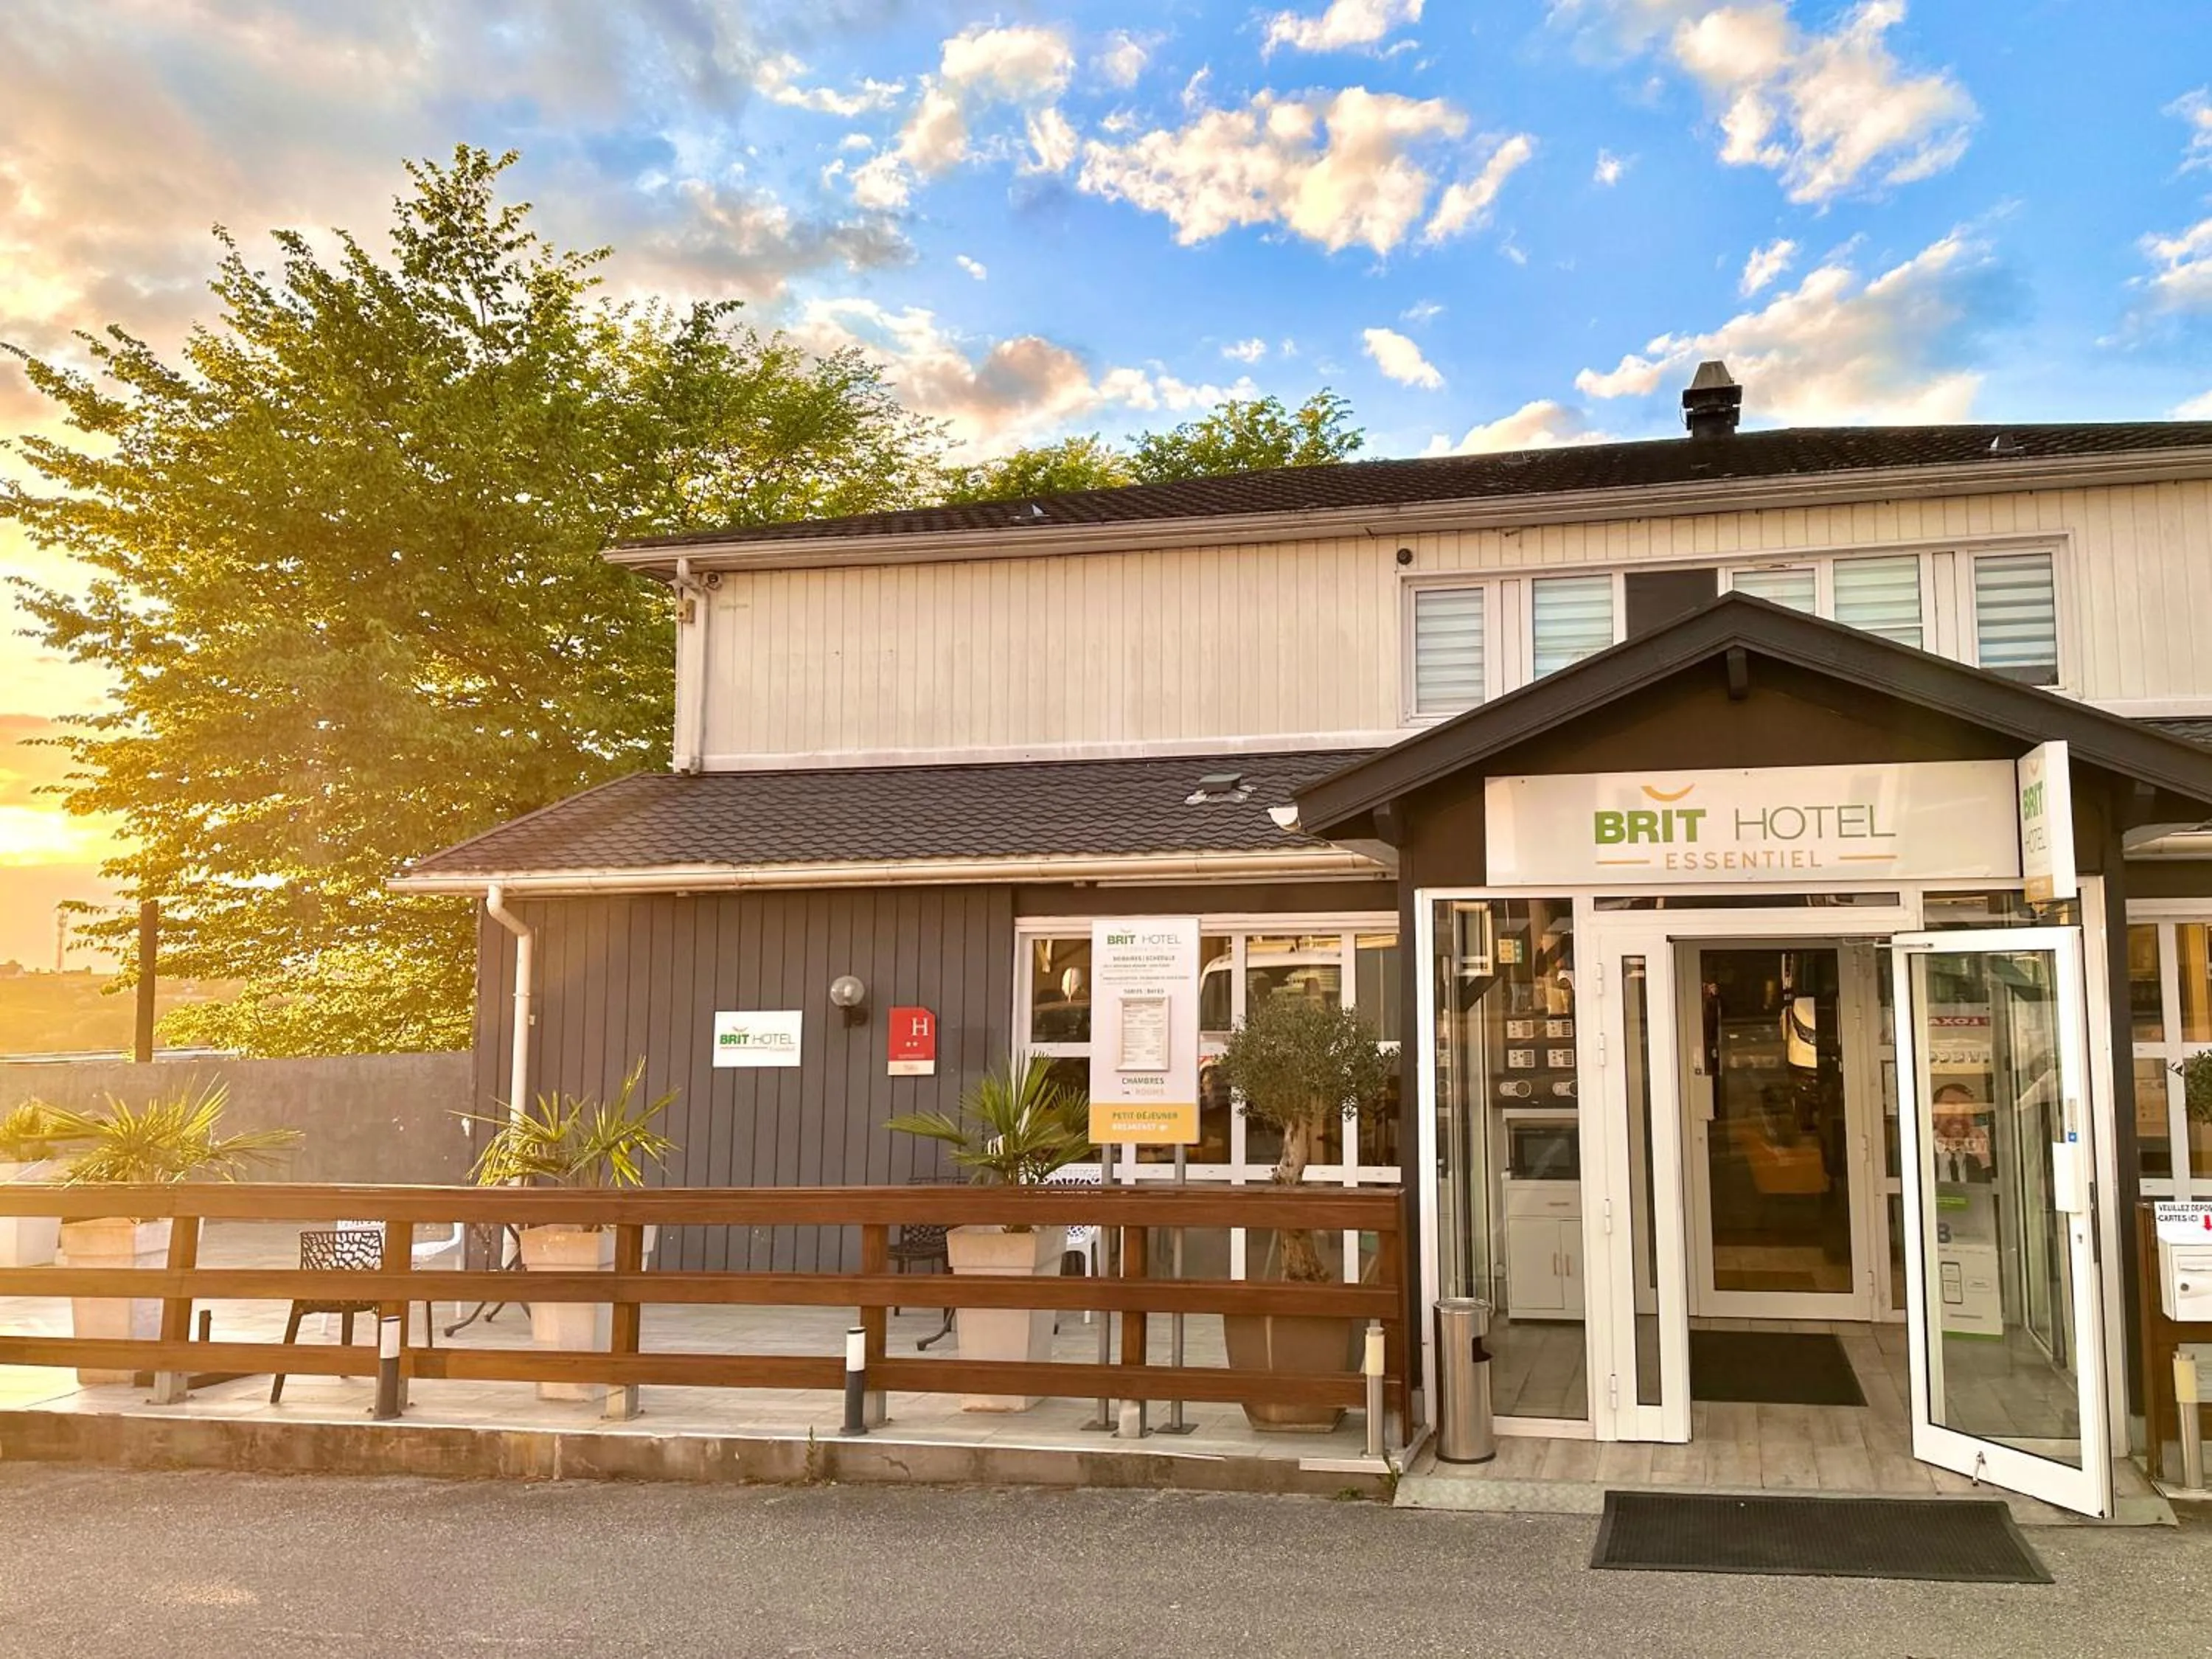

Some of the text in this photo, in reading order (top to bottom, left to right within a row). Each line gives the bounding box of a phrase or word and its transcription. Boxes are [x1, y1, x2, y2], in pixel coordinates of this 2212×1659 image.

[2023, 781, 2043, 821] BRIT
[1594, 804, 1896, 845] BRIT HOTEL
[1665, 849, 1823, 871] ESSENTIEL
[1107, 934, 1181, 945] BRIT HOTEL
[911, 1017, 929, 1036] H
[720, 1033, 796, 1045] BRIT HOTEL
